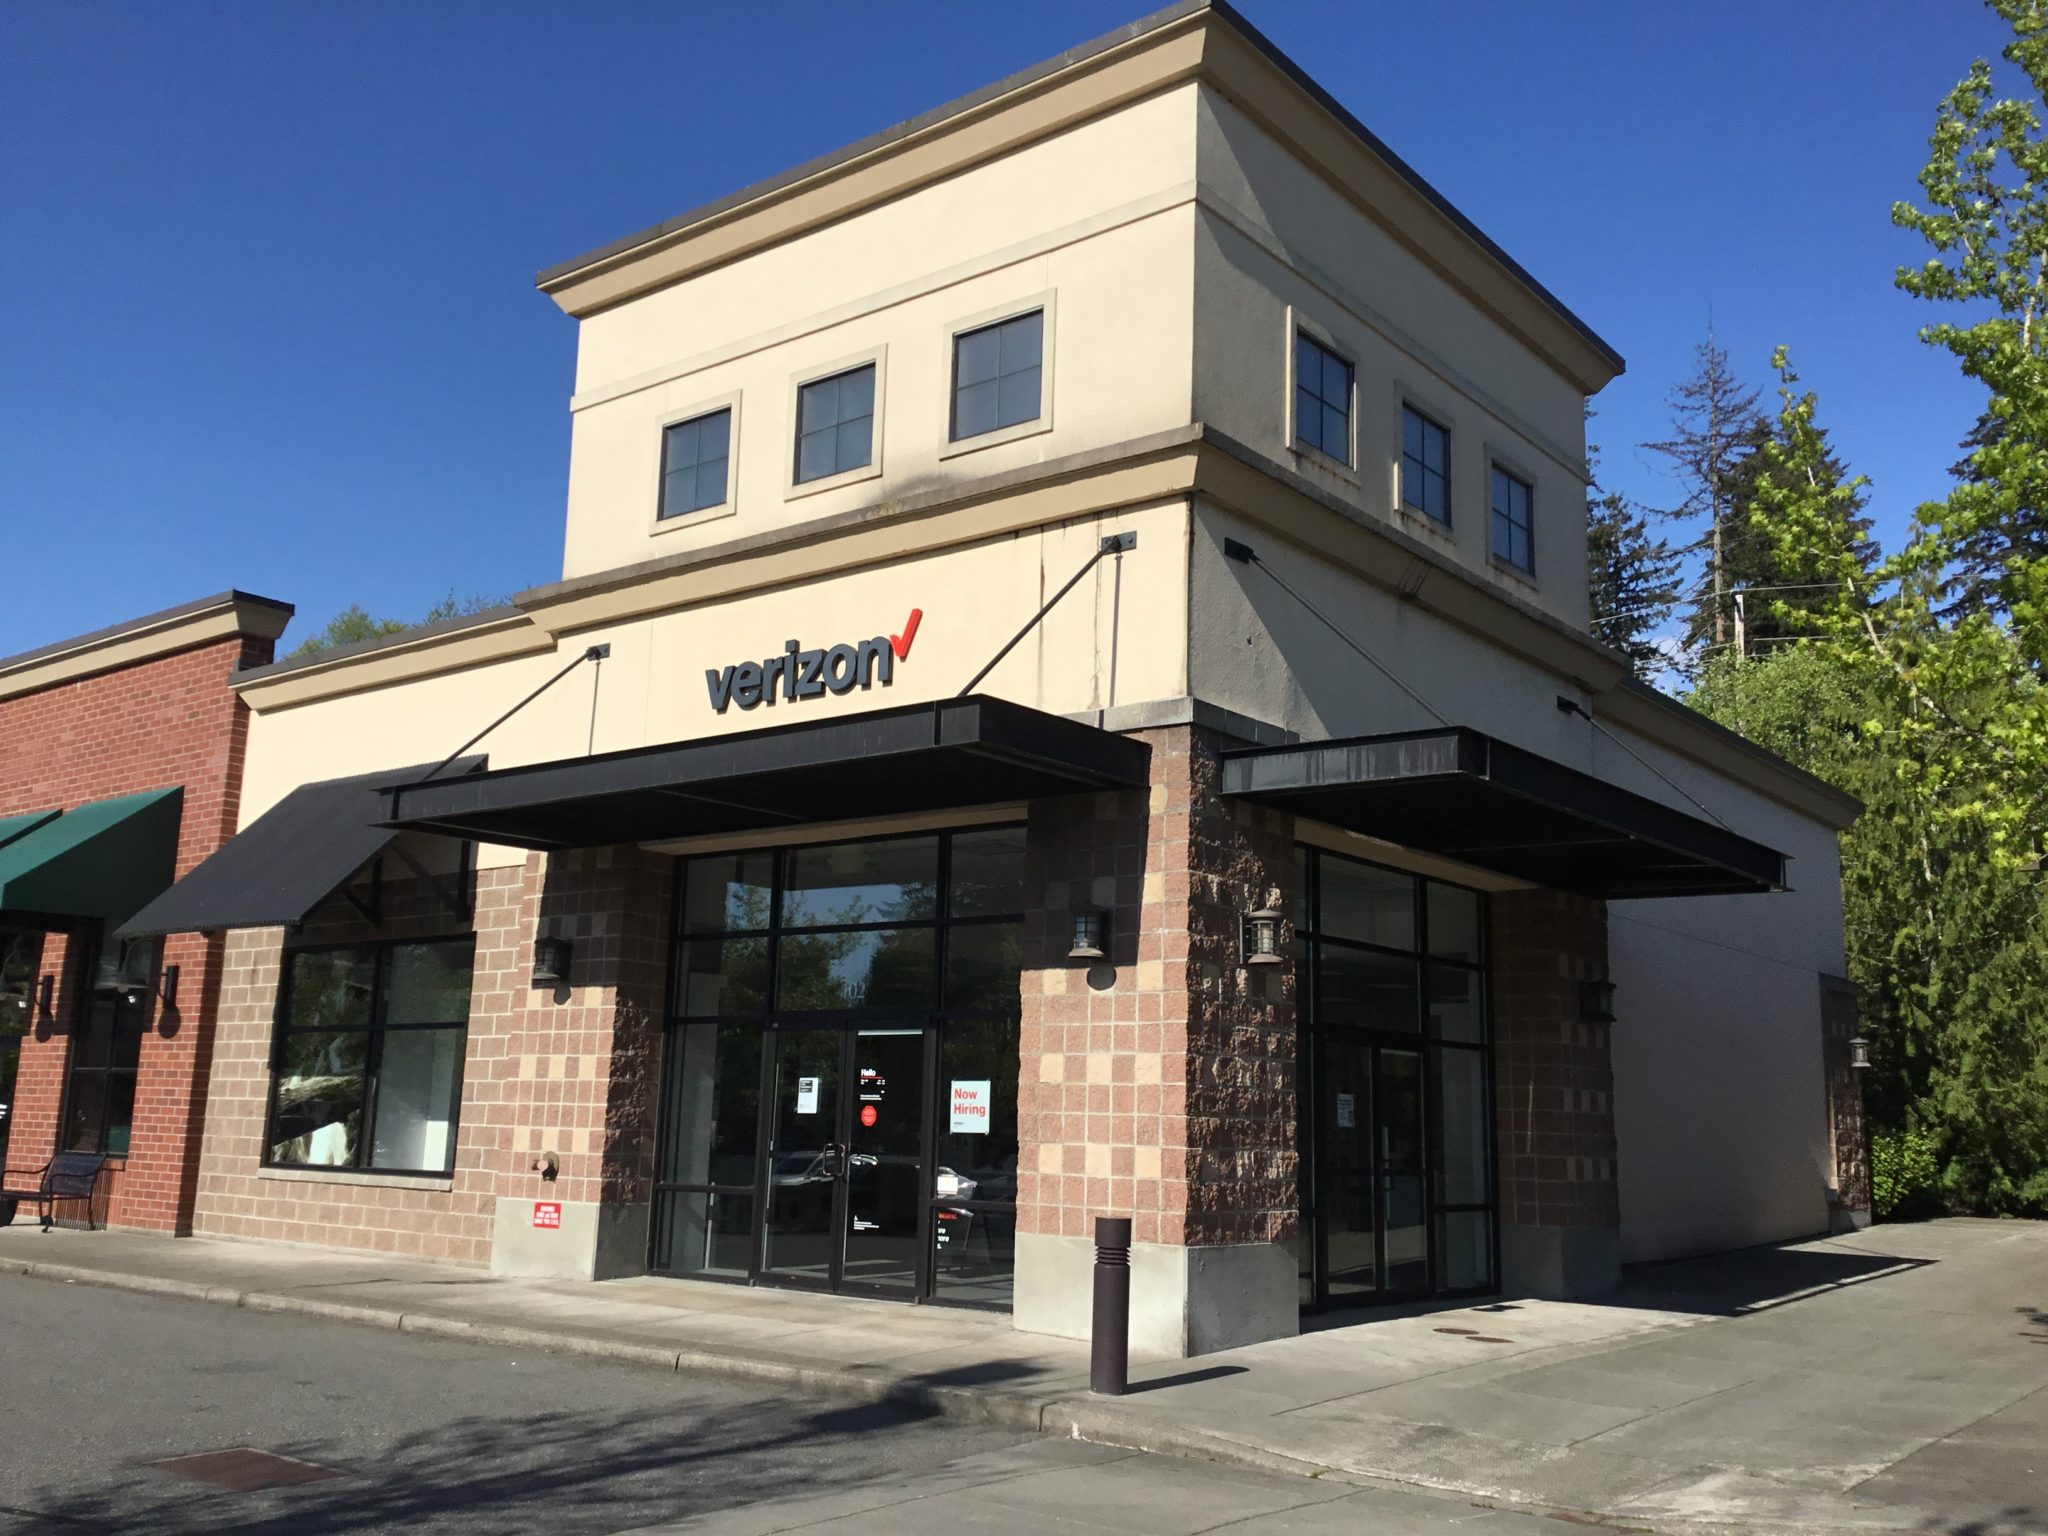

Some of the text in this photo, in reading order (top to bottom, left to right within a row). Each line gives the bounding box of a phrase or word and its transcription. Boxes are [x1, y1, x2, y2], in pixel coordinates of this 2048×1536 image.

[705, 636, 894, 713] verizon
[954, 1088, 978, 1100] Now
[953, 1103, 986, 1118] Hiring
